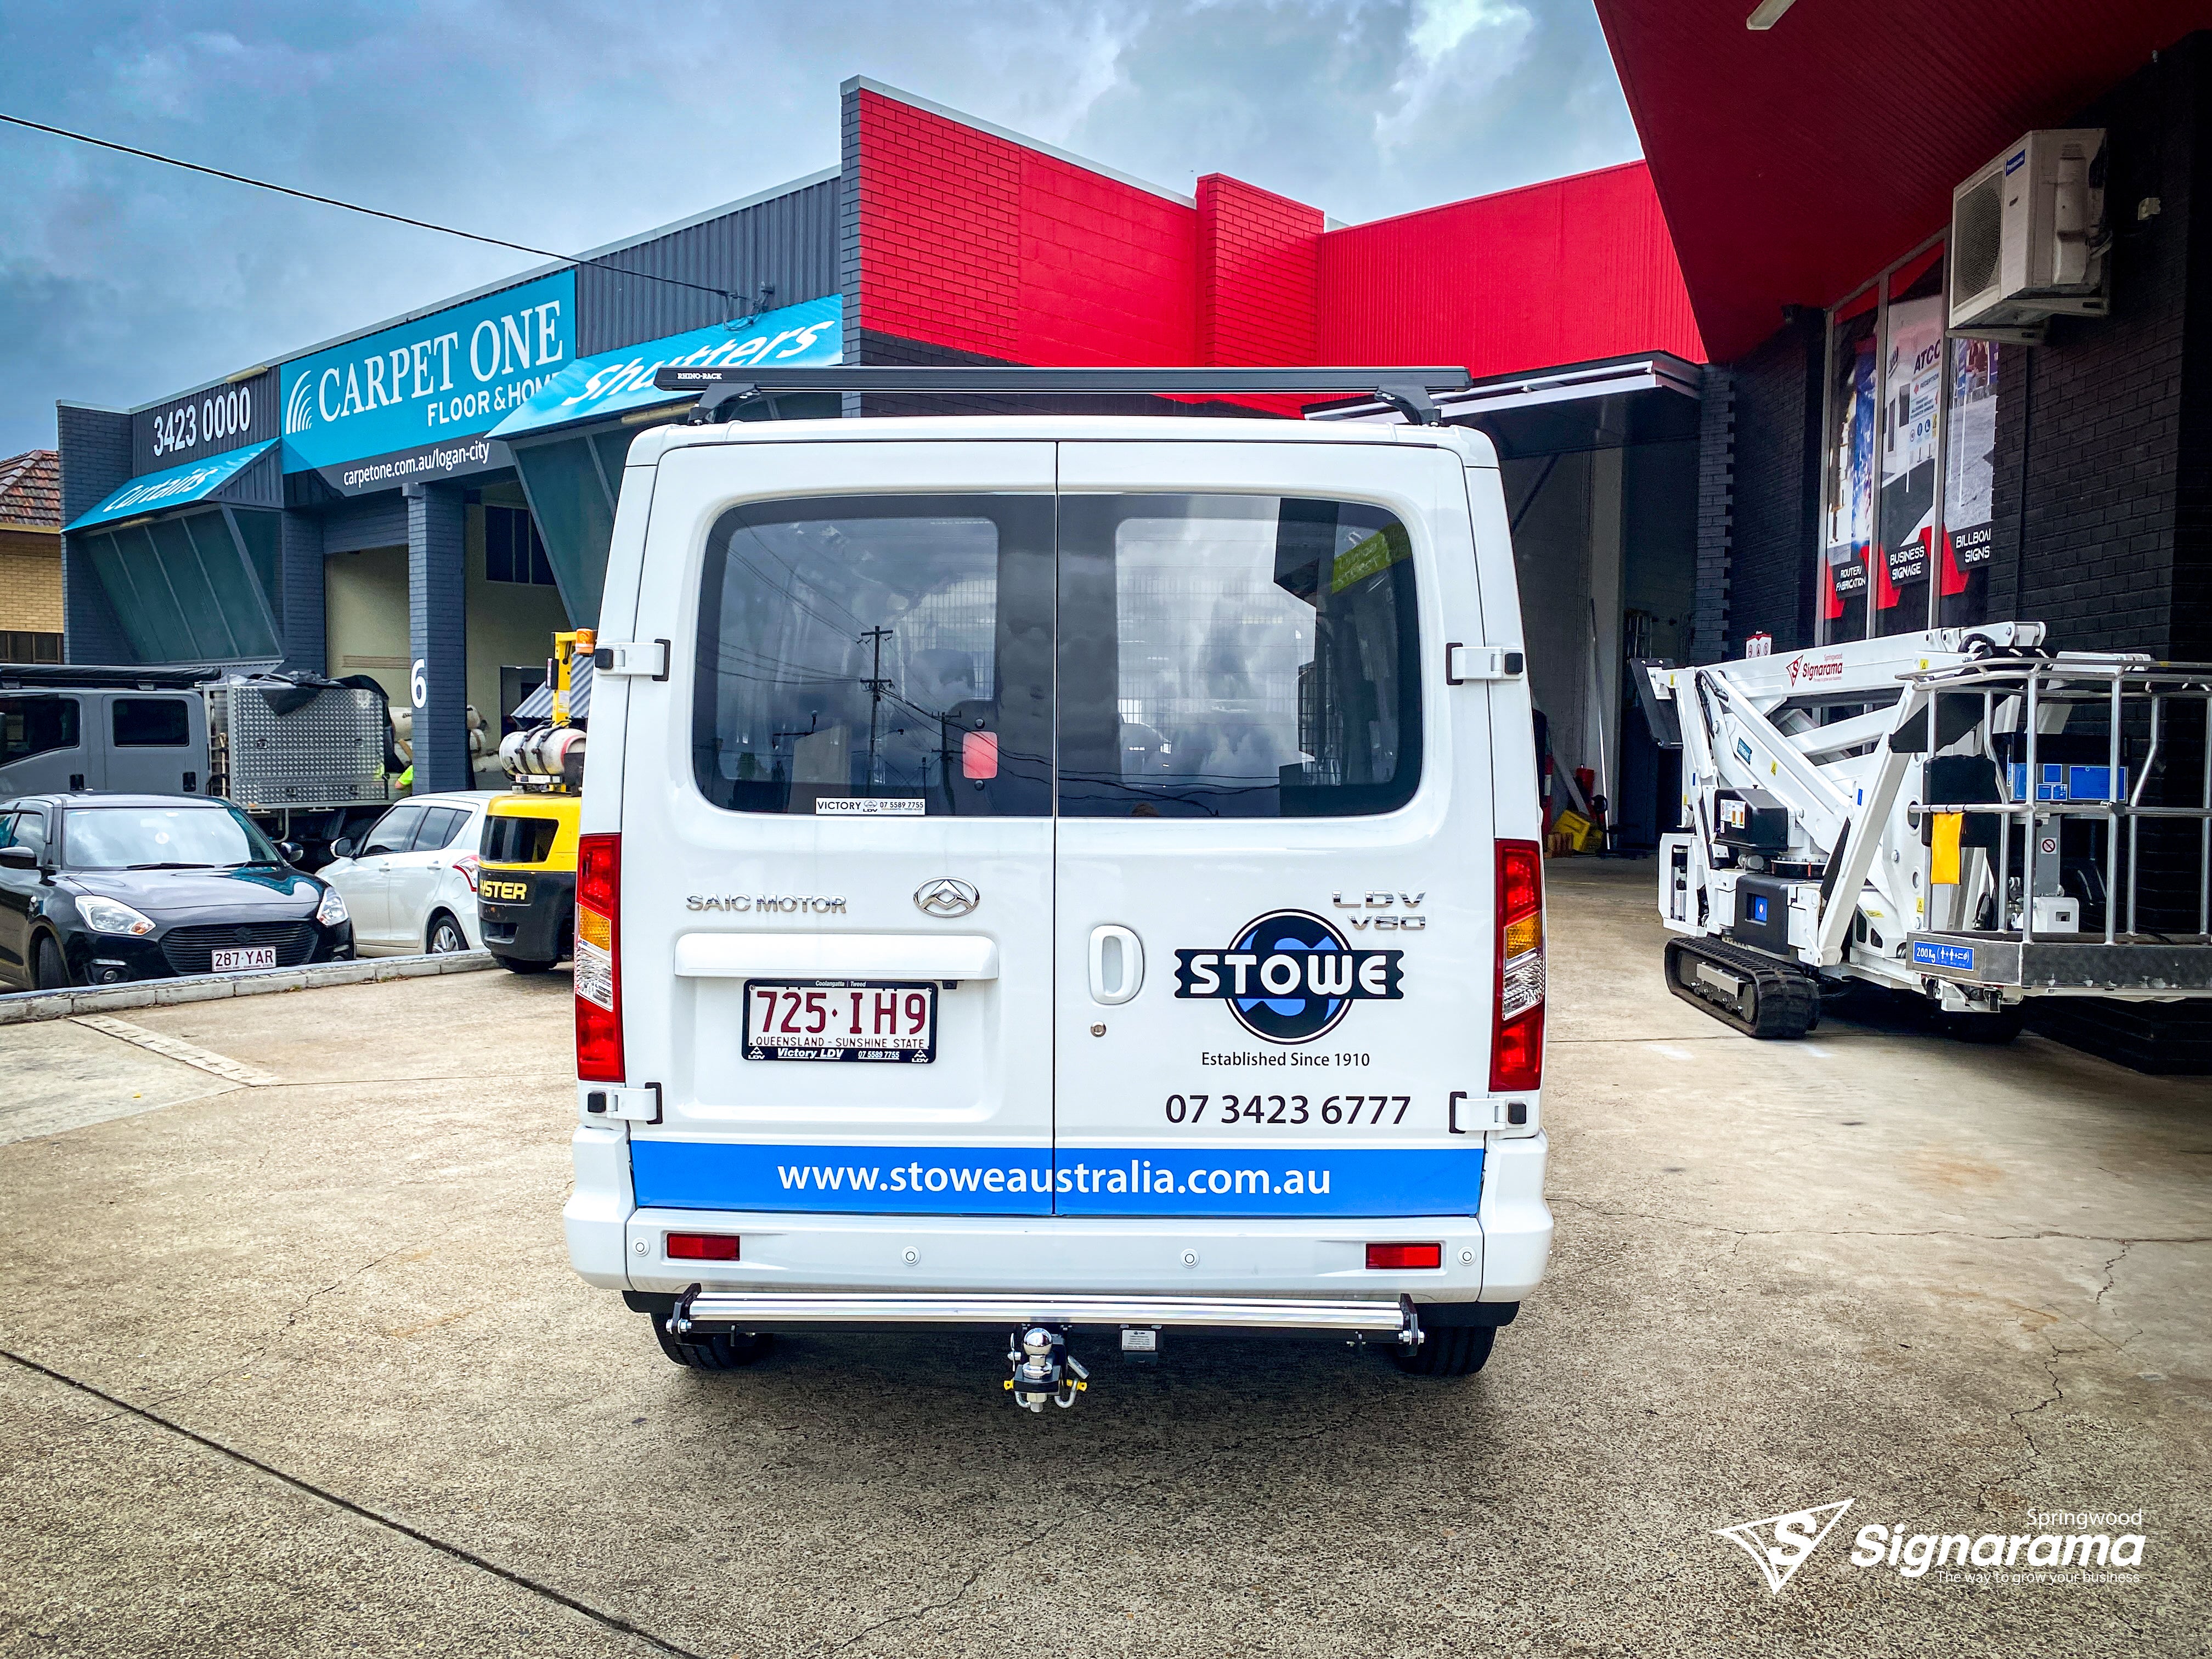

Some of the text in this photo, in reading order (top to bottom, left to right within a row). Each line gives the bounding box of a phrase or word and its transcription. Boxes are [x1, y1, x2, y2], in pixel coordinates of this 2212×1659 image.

[318, 300, 563, 422] CARPET ONE
[427, 390, 490, 427] FLOOR
[507, 373, 561, 408] HOM
[153, 386, 251, 456] 3423 0000
[343, 441, 489, 488] carpetone.com.au/logan-city
[103, 468, 219, 512] Curtains
[1955, 528, 1991, 549] BILLBOA
[1889, 545, 1925, 566] BUSINESS
[1965, 546, 1990, 563] SIGNS
[1892, 562, 1922, 580] SIGNAGE
[1836, 576, 1866, 592] FABRICATION
[1802, 662, 1843, 681] Signarama
[411, 659, 427, 708] 6
[817, 802, 861, 810] VICTORY
[686, 893, 847, 913] SAIC MOTOR
[1332, 890, 1426, 908] LDV
[1346, 913, 1426, 931] V80
[1189, 954, 1387, 995] STOWE
[756, 1036, 824, 1047] QUEENSLAND
[836, 1037, 888, 1048] SUNSHINE
[894, 1039, 924, 1048] STATE
[777, 1048, 818, 1058] Victory
[820, 1049, 844, 1058] LDV
[1201, 1052, 1370, 1067] Established Since 1910
[1166, 1094, 1412, 1125] 07 3423 6777
[777, 1159, 1331, 1195] www.stoweaustralia.com.au
